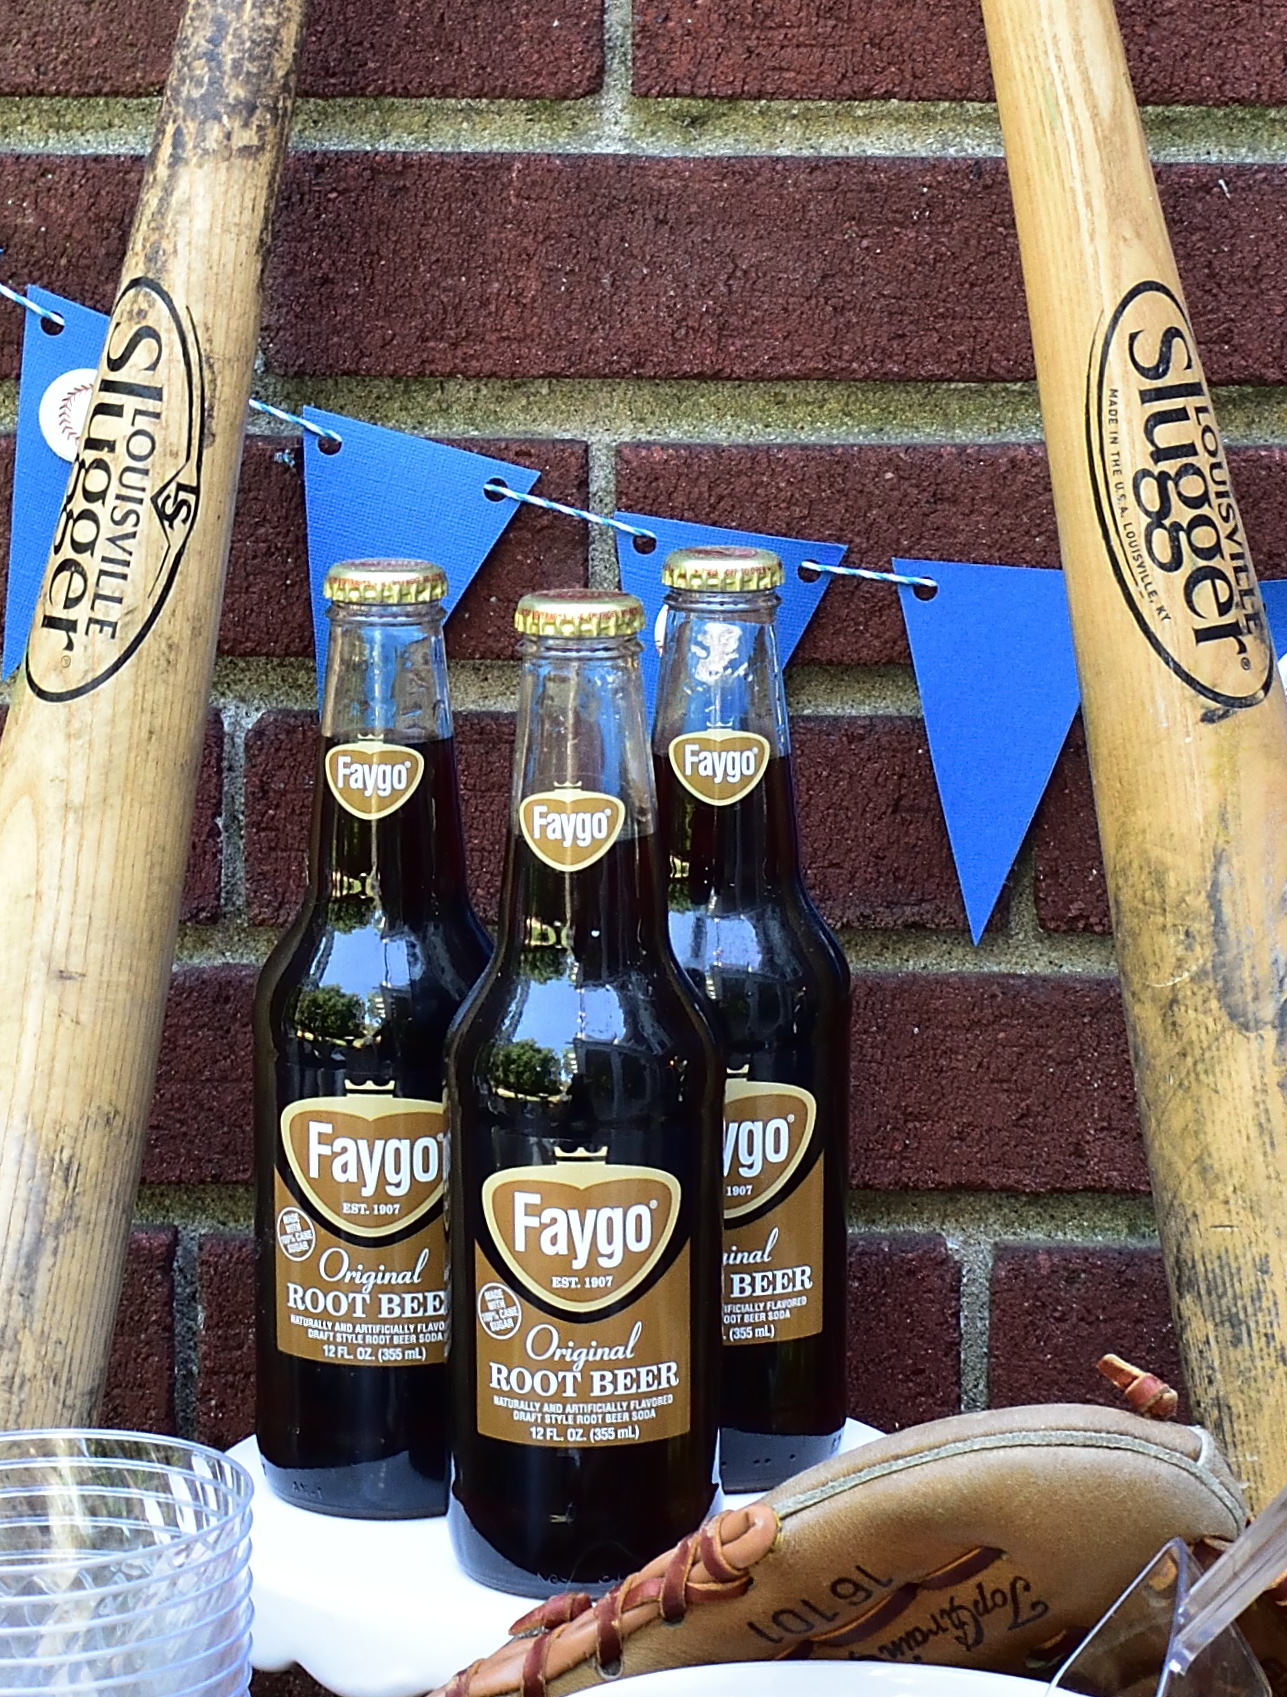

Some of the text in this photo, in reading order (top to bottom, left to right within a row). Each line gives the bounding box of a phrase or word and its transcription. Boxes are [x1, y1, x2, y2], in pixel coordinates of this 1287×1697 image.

[1108, 388, 1119, 424] MADE
[1109, 431, 1119, 445] IN
[1110, 451, 1123, 477] THE
[41, 321, 164, 651] Slugger
[1129, 326, 1247, 656] Slugger
[85, 409, 162, 639] LOUISVILLE
[1194, 406, 1259, 635] LOUISVILLE
[1156, 605, 1172, 622] KY
[336, 756, 408, 798] Faygo
[684, 745, 756, 788] Faygo
[532, 806, 608, 849] Faygo
[307, 1120, 439, 1197] Faygo
[723, 1120, 790, 1178] ygo
[726, 1185, 753, 1196] 1907
[342, 1202, 400, 1215] EST. 1907
[513, 1191, 652, 1270] Faygo
[723, 1227, 779, 1265] inal
[319, 1247, 429, 1292] Original
[551, 1276, 613, 1289] EST. 1907
[730, 1265, 813, 1298] BEER
[287, 1283, 447, 1318] ROOT BEE
[723, 1314, 742, 1324] OOT
[768, 1309, 791, 1321] SODA
[724, 1303, 765, 1313] IFICIALLY
[290, 1314, 445, 1334] NATURALLY AND ARTIFICIALLY FLAVO
[307, 1329, 444, 1345] DRAFT STYLE ROOT BEER SODA
[729, 1326, 753, 1342] (355
[323, 1344, 427, 1362] 12 FL. OZ. (355 mL)
[526, 1320, 642, 1371] Original
[489, 1361, 680, 1397] ROOT BEER
[493, 1394, 673, 1414] NATURALLY AND ARTIFICIALLY FLAVORED
[513, 1409, 656, 1424] DRAFT STYLE ROOT BEER SODA
[530, 1425, 640, 1443] 12 FL. OZ. (355 mL)
